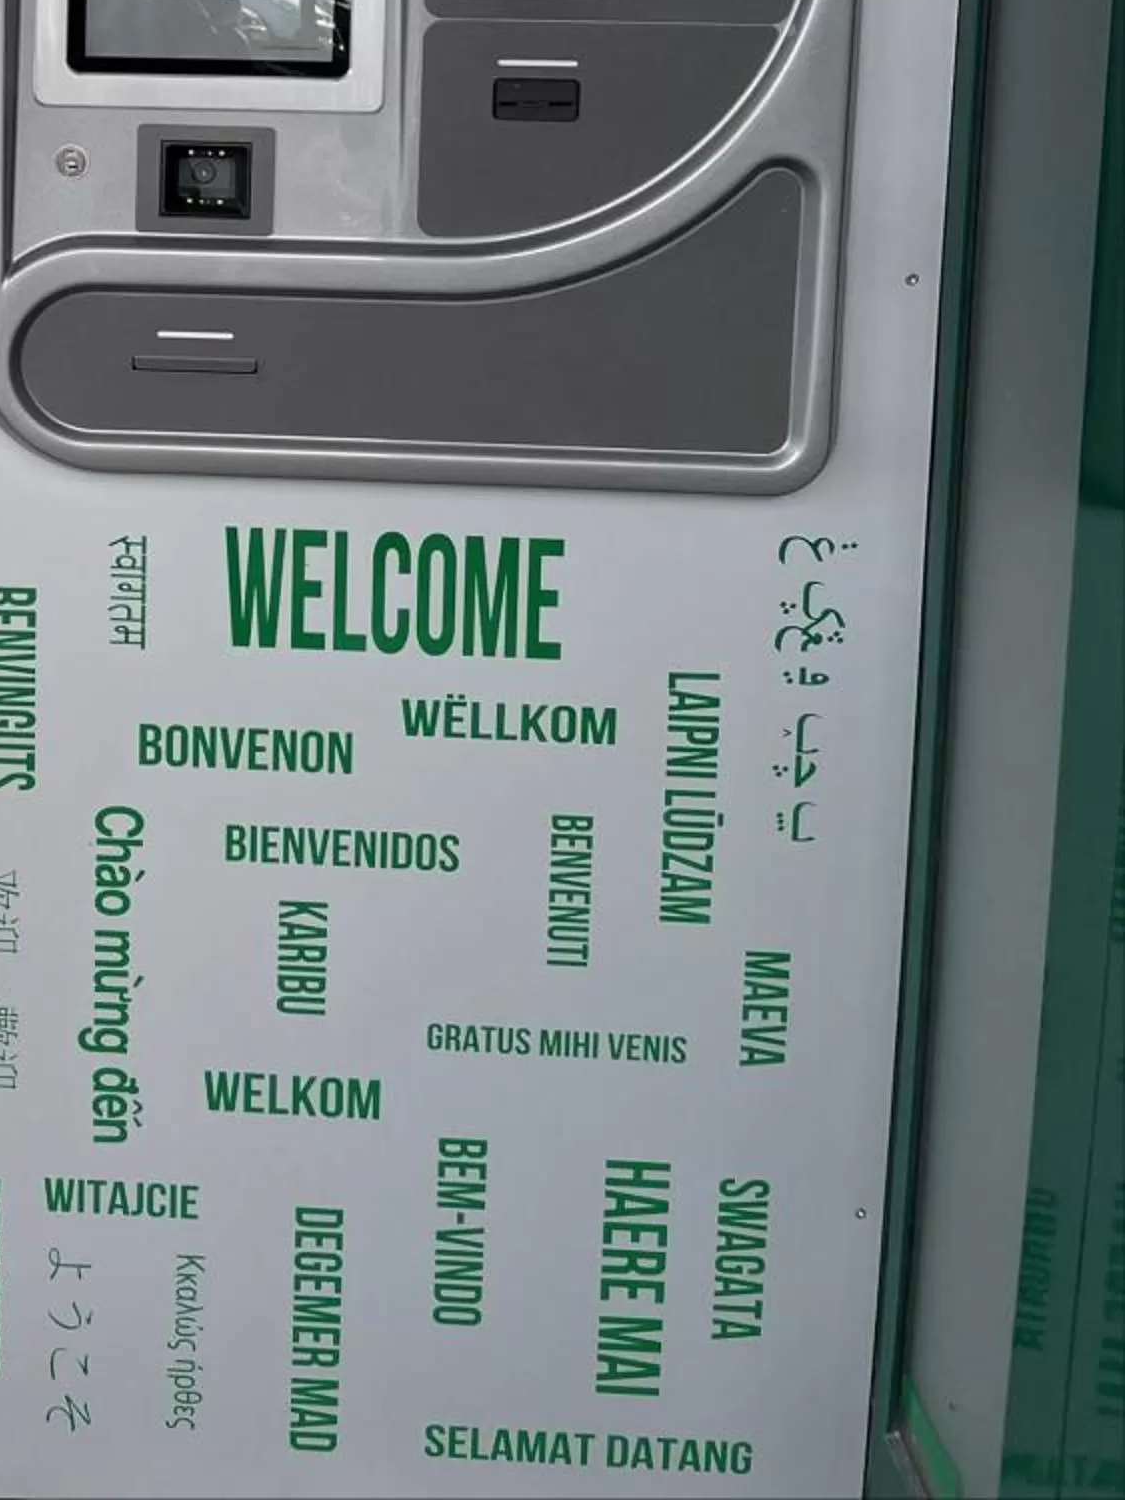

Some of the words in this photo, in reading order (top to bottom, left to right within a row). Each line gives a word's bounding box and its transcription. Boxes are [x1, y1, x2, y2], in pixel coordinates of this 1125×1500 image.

[225, 526, 565, 661] WELCOME
[138, 723, 353, 775] BONVENON
[401, 693, 617, 745] WËLLKOM
[665, 672, 721, 779] LAIPNI
[94, 806, 146, 917] Chào
[225, 824, 460, 873] BIENVENIDOS
[546, 814, 594, 967] BENVENUTI
[658, 789, 724, 924] LŪDZAM
[77, 929, 144, 1054] mừng
[276, 900, 329, 1016] KARIBU
[739, 951, 791, 1067] MAEVA
[204, 1070, 381, 1120] WELKOM
[427, 1023, 532, 1055] GRATUS
[539, 1029, 599, 1059] MIHI
[608, 1032, 687, 1064] VENIS
[92, 1067, 143, 1143] đến
[44, 1177, 199, 1220] WITAJCIE
[432, 1137, 488, 1326] BEM-VINDO
[600, 1159, 672, 1304] HAERE
[291, 1207, 344, 1368] DEGEMER
[711, 1178, 770, 1340] SWAGATA
[45, 1247, 92, 1433] ようこそ
[595, 1315, 664, 1397] MAI
[289, 1377, 340, 1452] MAD
[424, 1424, 596, 1466] SELAMAT
[606, 1435, 753, 1475] DATANG
